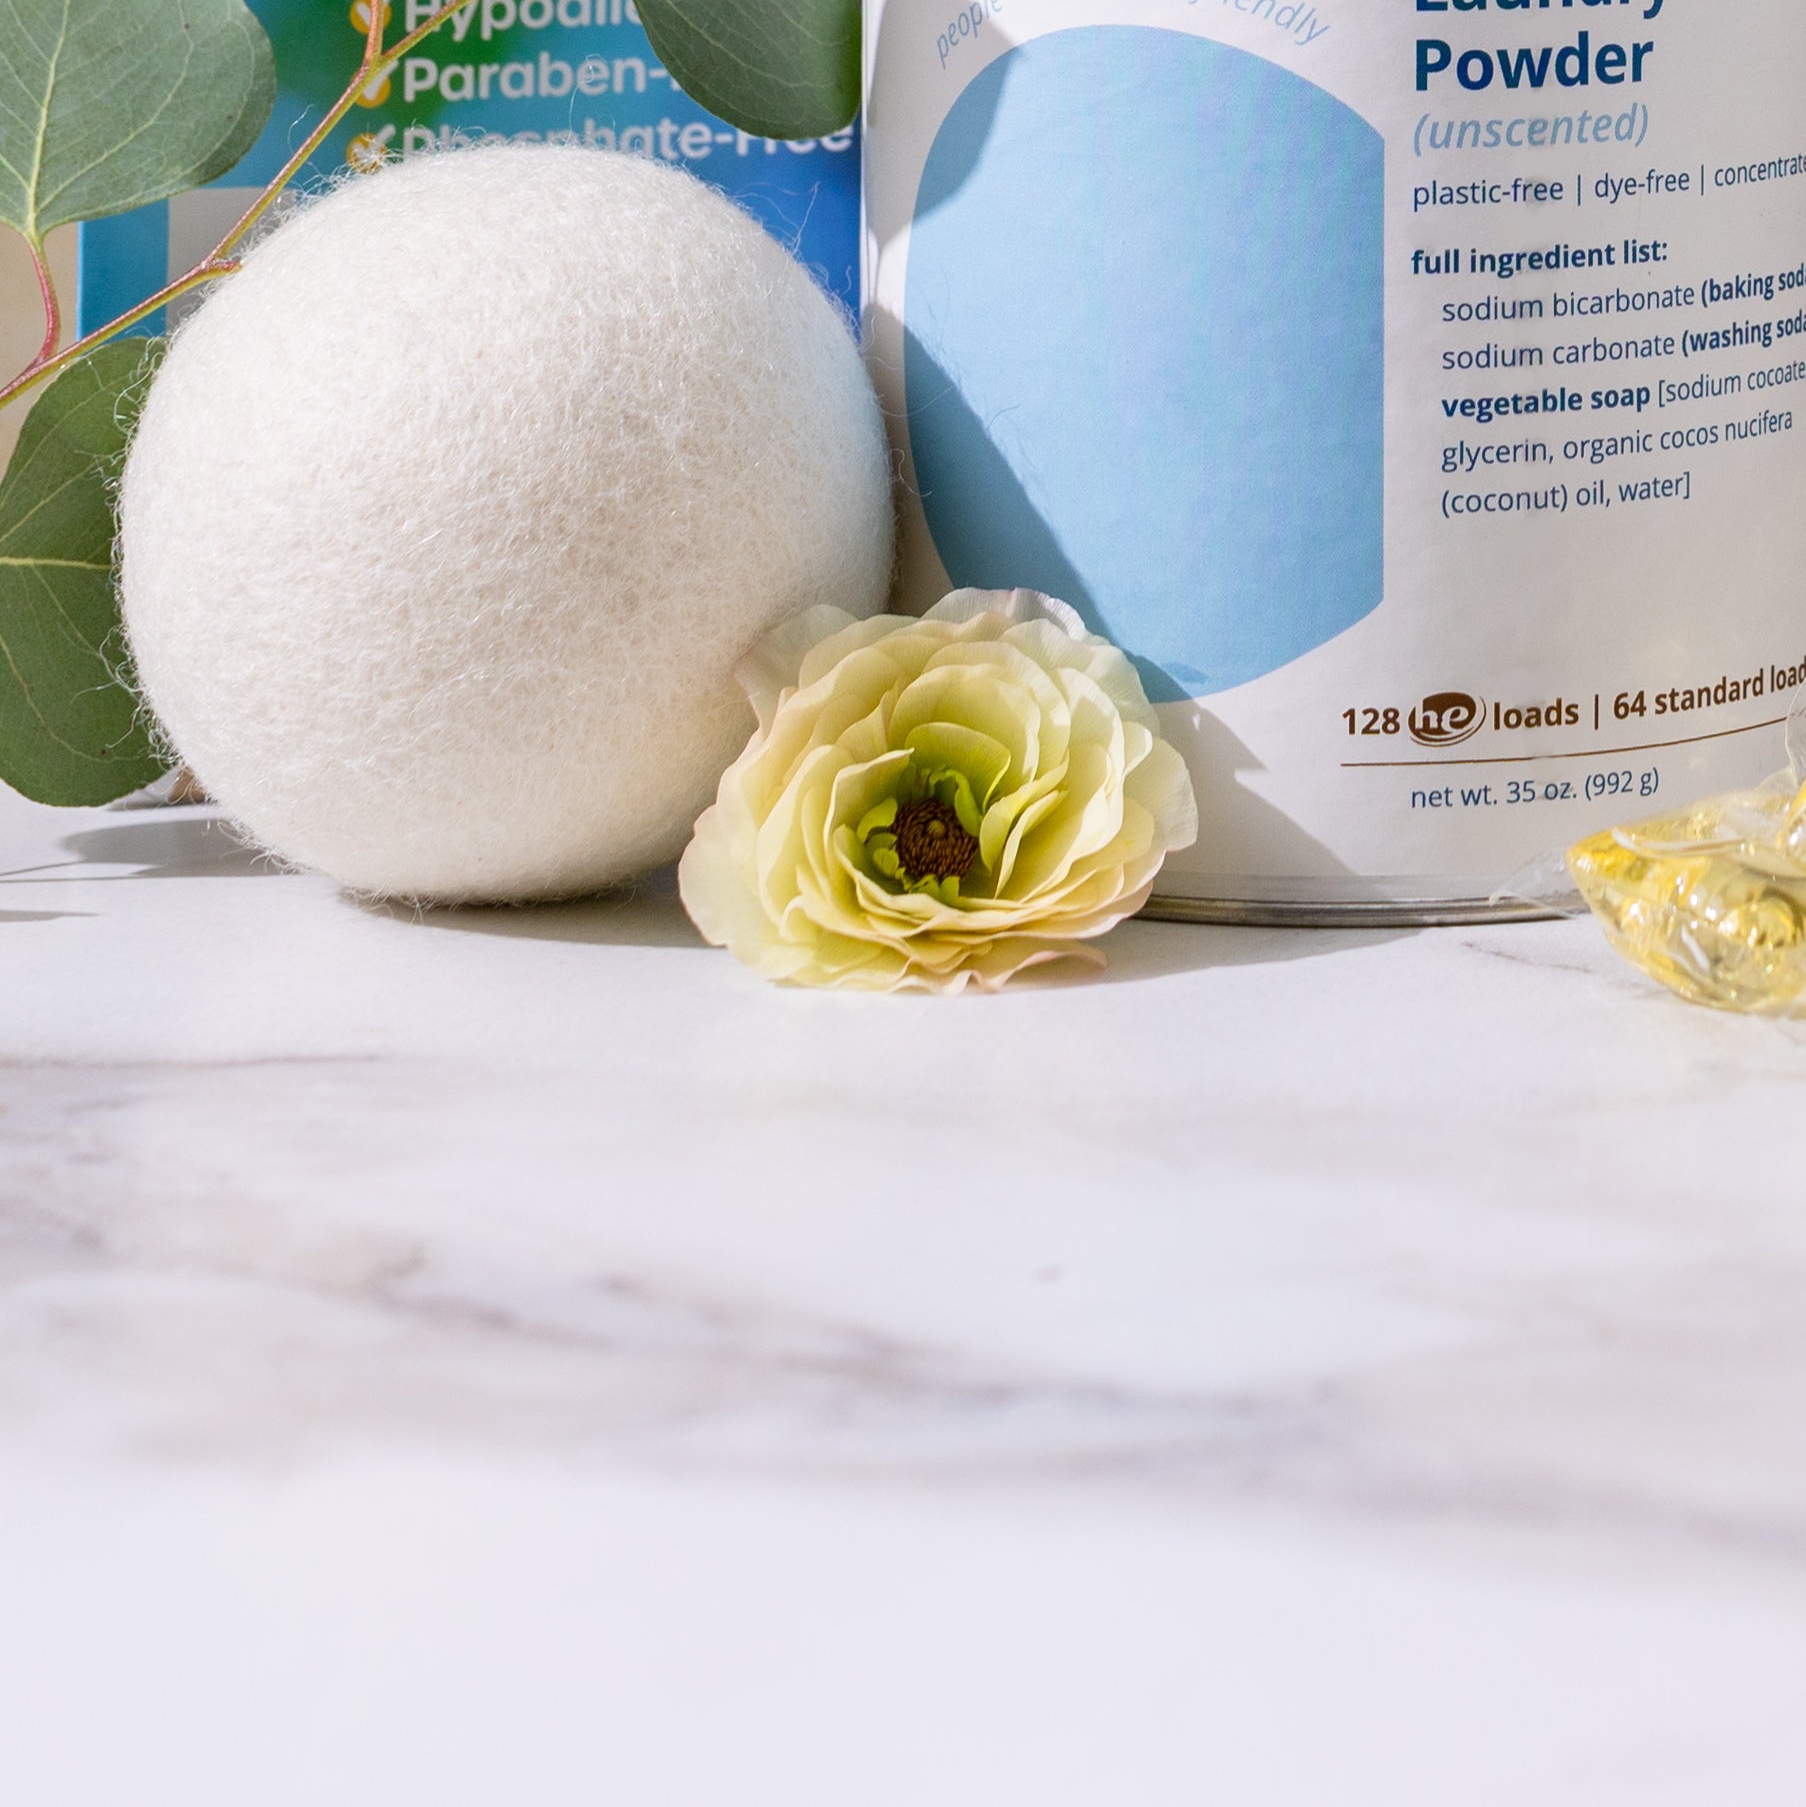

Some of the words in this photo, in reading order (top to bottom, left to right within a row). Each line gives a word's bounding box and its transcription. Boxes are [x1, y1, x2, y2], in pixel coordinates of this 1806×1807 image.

[1415, 30, 1655, 92] Powder
[1412, 101, 1650, 158] (unscented)
[1412, 177, 1564, 213] plastic-free
[1593, 168, 1691, 205] dye-free
[1410, 248, 1460, 276] full
[1469, 243, 1616, 280] ingredient
[1622, 238, 1668, 265] list:
[1441, 294, 1544, 323] sodium
[1552, 284, 1696, 318] bicarbonate
[1700, 272, 1775, 309] (baking
[1441, 342, 1544, 371] sodium
[1552, 334, 1676, 366] carbonate
[1681, 318, 1773, 358] (washing
[1440, 386, 1584, 424] vegetable
[1590, 386, 1651, 414] soap
[1658, 373, 1742, 409] [sodium
[1440, 438, 1554, 474] glycerin,
[1562, 429, 1654, 465] organic
[1659, 424, 1720, 451] cocos
[1724, 409, 1793, 442] nucifera
[1441, 483, 1569, 520] (coconut)
[1575, 478, 1611, 509] oil,
[1617, 470, 1691, 503] water]
[1340, 707, 1401, 736] 128
[1493, 697, 1580, 731] loads
[1612, 689, 1648, 721] 64
[1654, 667, 1765, 716] standard
[1410, 786, 1454, 810] net
[1459, 784, 1498, 807] wt.
[1505, 779, 1537, 805] 35
[1543, 781, 1578, 802] oz.
[1584, 770, 1634, 802] (992
[1639, 766, 1660, 798] g)
